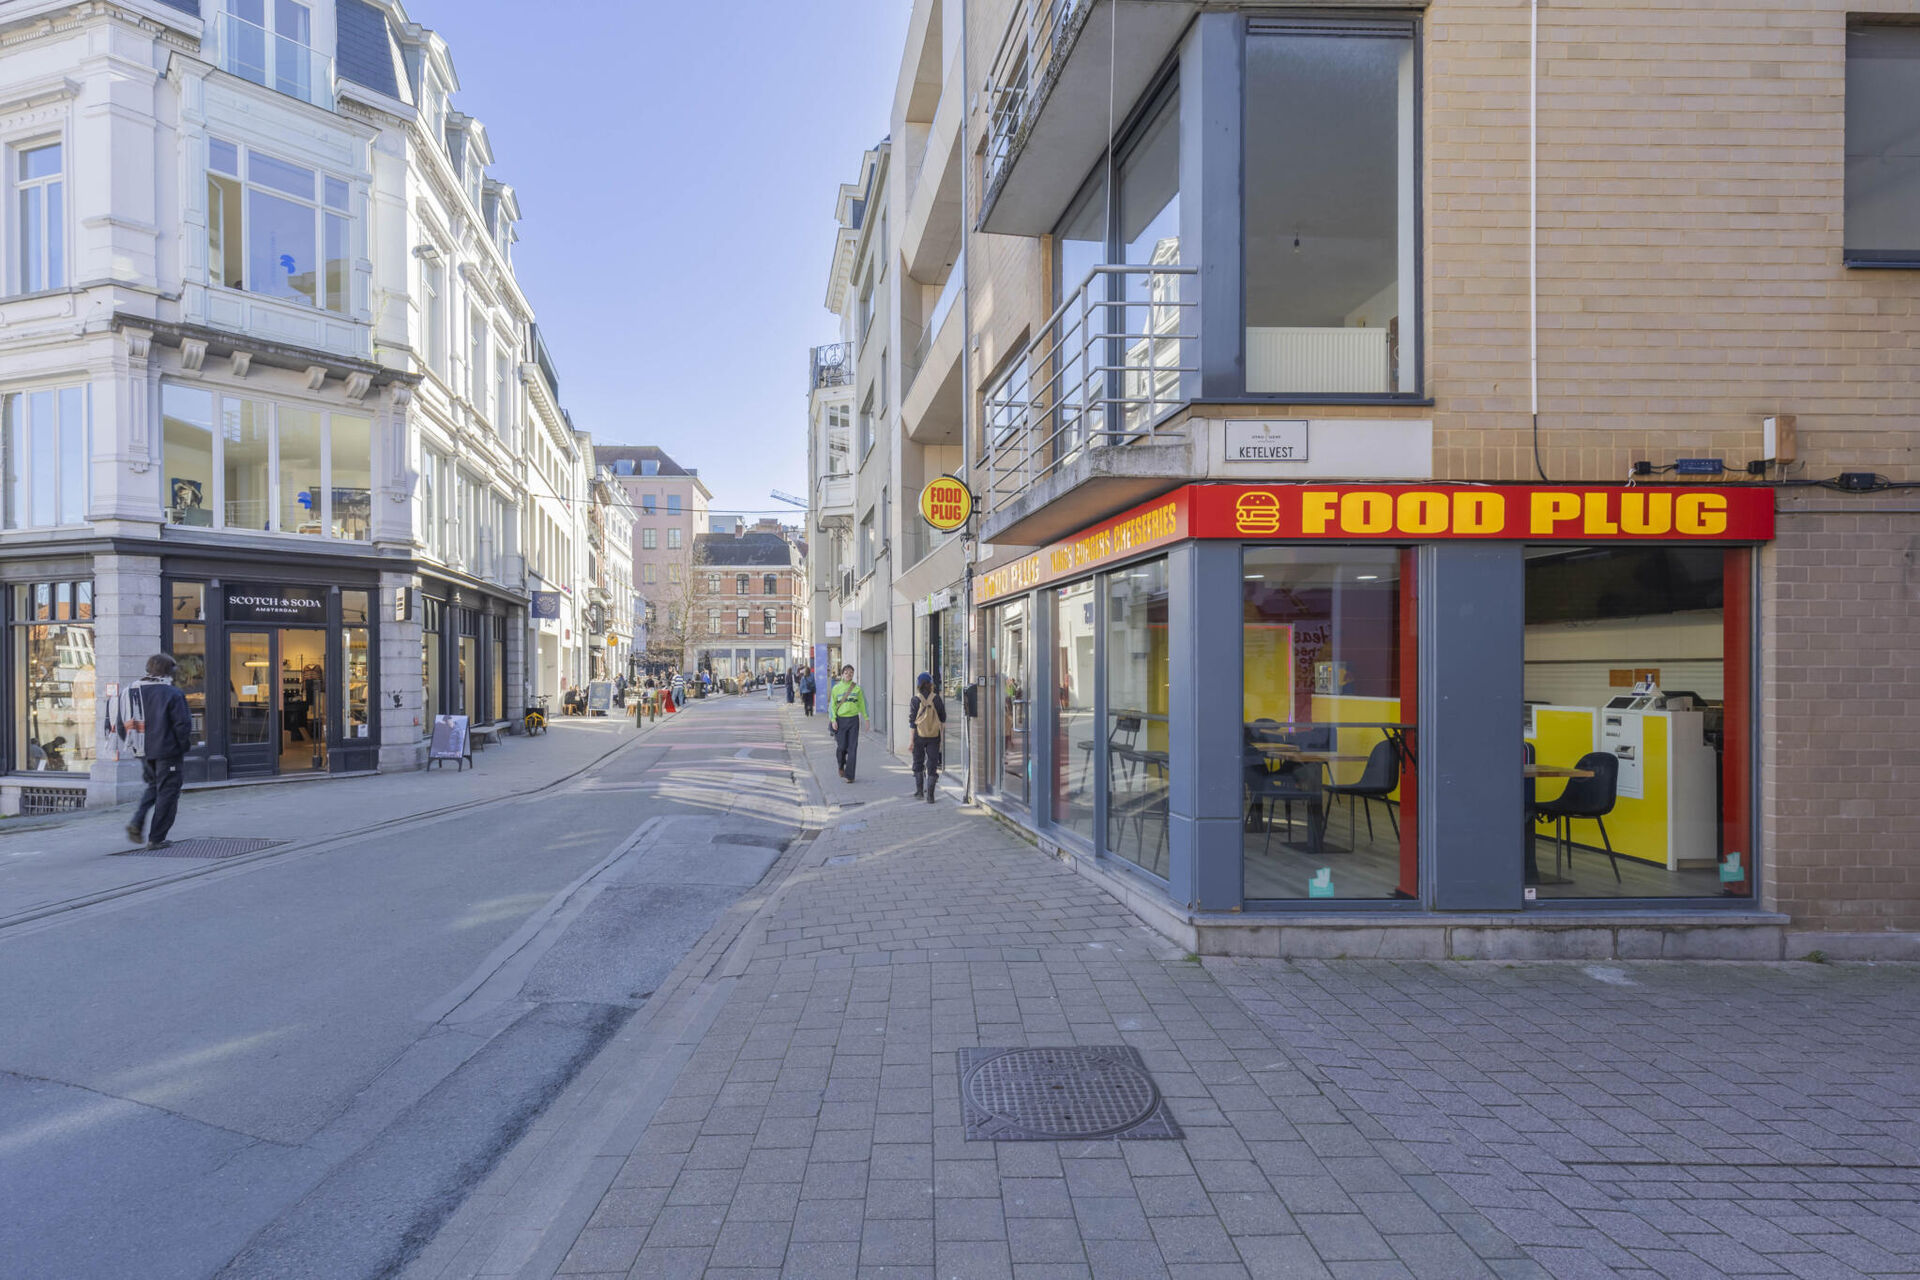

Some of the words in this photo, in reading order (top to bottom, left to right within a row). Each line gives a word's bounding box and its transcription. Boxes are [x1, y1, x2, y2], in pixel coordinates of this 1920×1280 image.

[1240, 446, 1293, 458] KETELVEST
[930, 486, 962, 504] FOOD
[930, 503, 962, 521] PLUG
[1302, 491, 1505, 534] FOOD
[1530, 492, 1727, 535] PLUG
[984, 567, 1008, 600] FOOD
[1010, 555, 1040, 588] PLUG
[1075, 529, 1111, 567] BURGERS
[1113, 502, 1177, 553] CHEESEFRIES
[229, 595, 279, 606] SCOTCH
[290, 598, 322, 608] SODA
